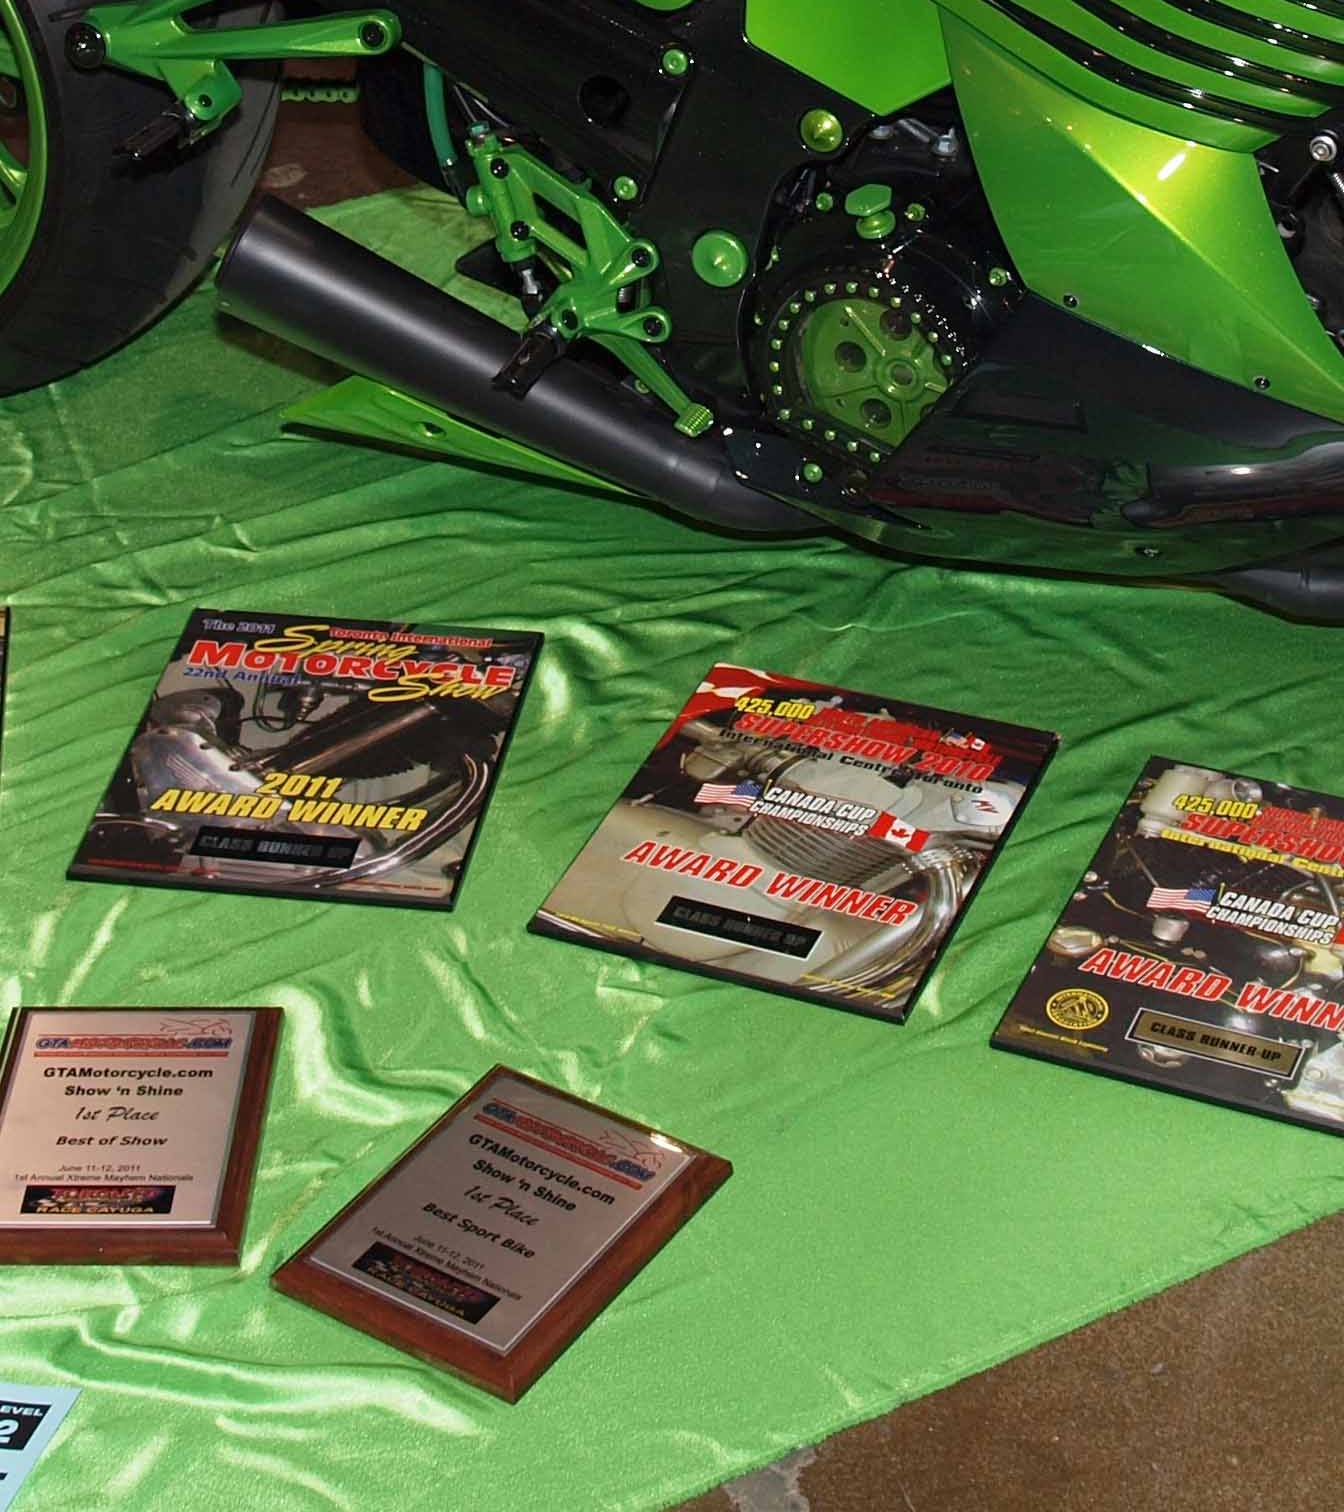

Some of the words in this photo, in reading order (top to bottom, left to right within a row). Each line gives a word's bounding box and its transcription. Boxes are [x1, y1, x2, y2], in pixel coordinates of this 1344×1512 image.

[254, 624, 418, 666] Spring
[183, 666, 226, 679] 22nd
[187, 639, 516, 687] MOTORCYCLE
[368, 672, 510, 702] Show
[719, 728, 834, 761] International
[735, 712, 919, 765] SUPERSHOW
[913, 751, 997, 782] 2010
[255, 772, 345, 799] 2011
[150, 788, 284, 820] AWARD
[288, 799, 429, 832] WINNER
[750, 800, 870, 838] CHAMPIONSHIPS
[765, 788, 834, 816] CANADA
[836, 803, 877, 821] CUP
[622, 840, 763, 889] AWARD
[765, 872, 919, 927] WINNER
[1206, 906, 1335, 945] CHAMPIONSHIPS
[1220, 891, 1296, 919] CANADA
[1296, 908, 1341, 928] CUP
[1079, 948, 1232, 1002] AWARD
[1150, 1021, 1197, 1042] CLASS
[43, 1067, 214, 1080] GTAMotorcycle.com
[64, 1085, 111, 1096] Show
[136, 1085, 184, 1096] Shine
[75, 1106, 102, 1121] 1st
[105, 1105, 160, 1122] Place
[55, 1135, 95, 1146] Best
[98, 1135, 117, 1146] of
[119, 1135, 168, 1146] Show
[58, 1164, 83, 1173] June
[117, 1164, 141, 1172] 2011
[67, 1174, 102, 1182] Xtreme
[104, 1174, 146, 1183] Mayhem
[469, 1134, 616, 1205] GTAMotorcycle.com
[473, 1159, 515, 1184] Show
[534, 1185, 577, 1212] Shine
[422, 1202, 459, 1223] Best
[458, 1218, 501, 1243] Sport
[501, 1238, 536, 1259] Bike
